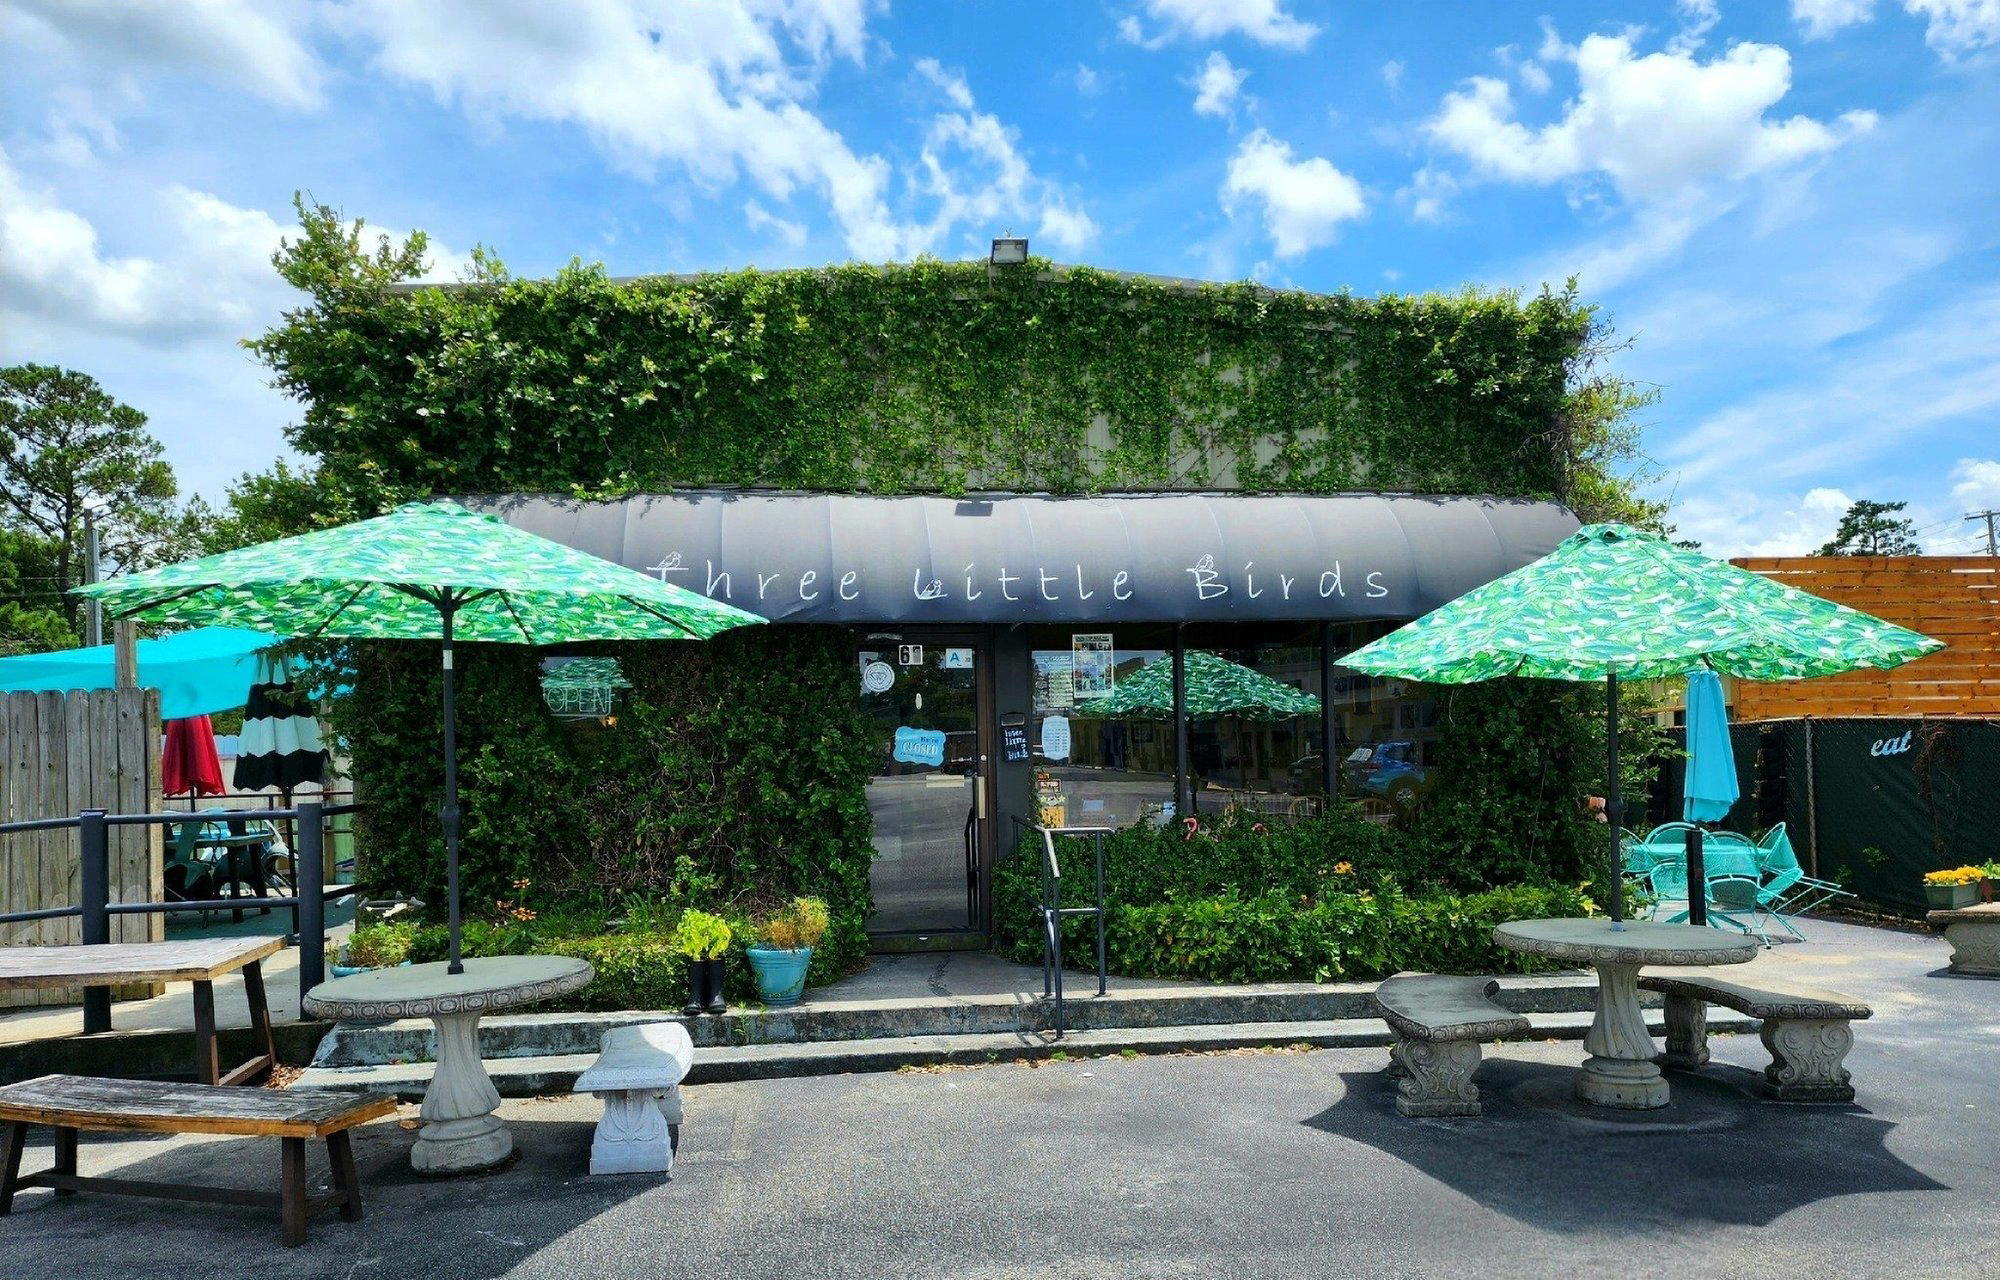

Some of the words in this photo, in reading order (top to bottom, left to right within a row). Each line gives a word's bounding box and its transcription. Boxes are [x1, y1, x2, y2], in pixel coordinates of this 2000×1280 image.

[646, 559, 860, 600] Three
[913, 562, 1133, 601] Little
[1186, 560, 1390, 601] Birds
[547, 686, 608, 713] OPEN
[902, 741, 939, 757] CLOSED
[1870, 730, 1913, 757] eat
